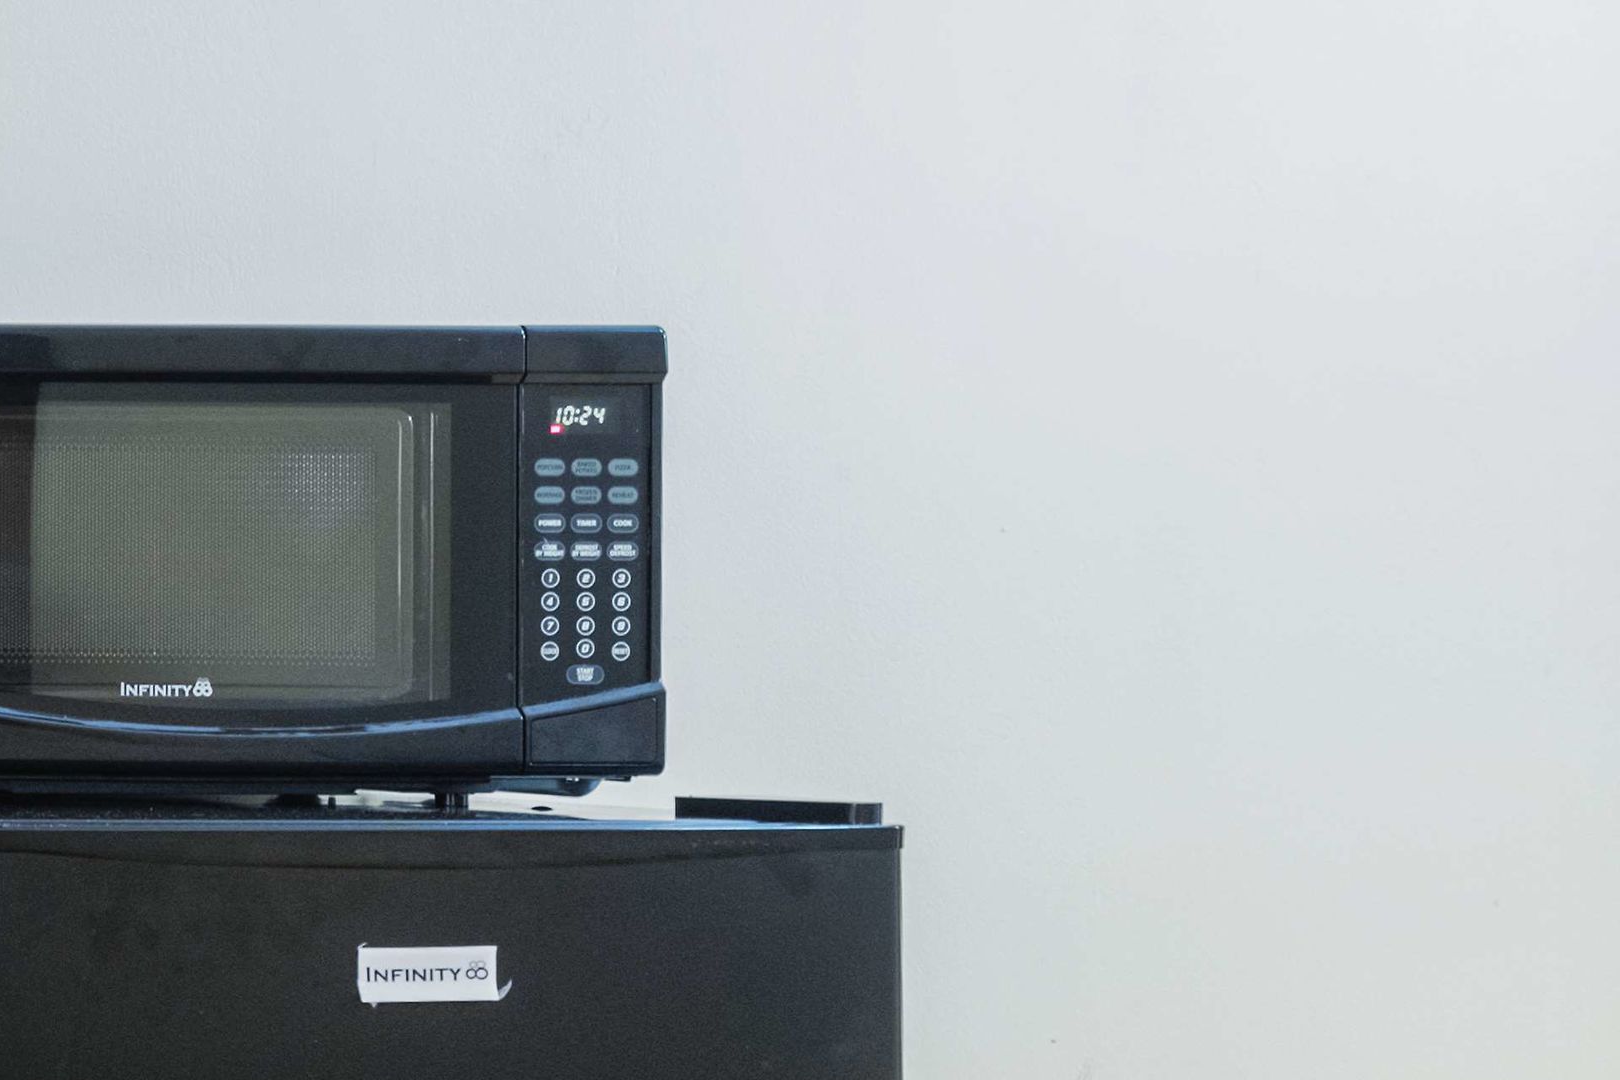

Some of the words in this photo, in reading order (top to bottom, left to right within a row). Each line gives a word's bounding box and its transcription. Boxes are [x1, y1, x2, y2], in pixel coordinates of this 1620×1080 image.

[555, 405, 606, 426] 10:24
[538, 519, 561, 527] POWER
[576, 519, 596, 527] TIMER
[613, 519, 632, 527] COOK
[548, 573, 553, 583] 1
[581, 573, 591, 583] 2
[617, 573, 626, 583] 3
[546, 596, 554, 606] 4
[581, 596, 590, 606] 5
[617, 596, 626, 606] 6
[546, 620, 554, 631] 7
[581, 621, 590, 631] 8
[616, 621, 626, 631] 9
[581, 643, 590, 654] 0
[120, 681, 192, 697] INFINITY
[366, 967, 461, 982] INFINITY
